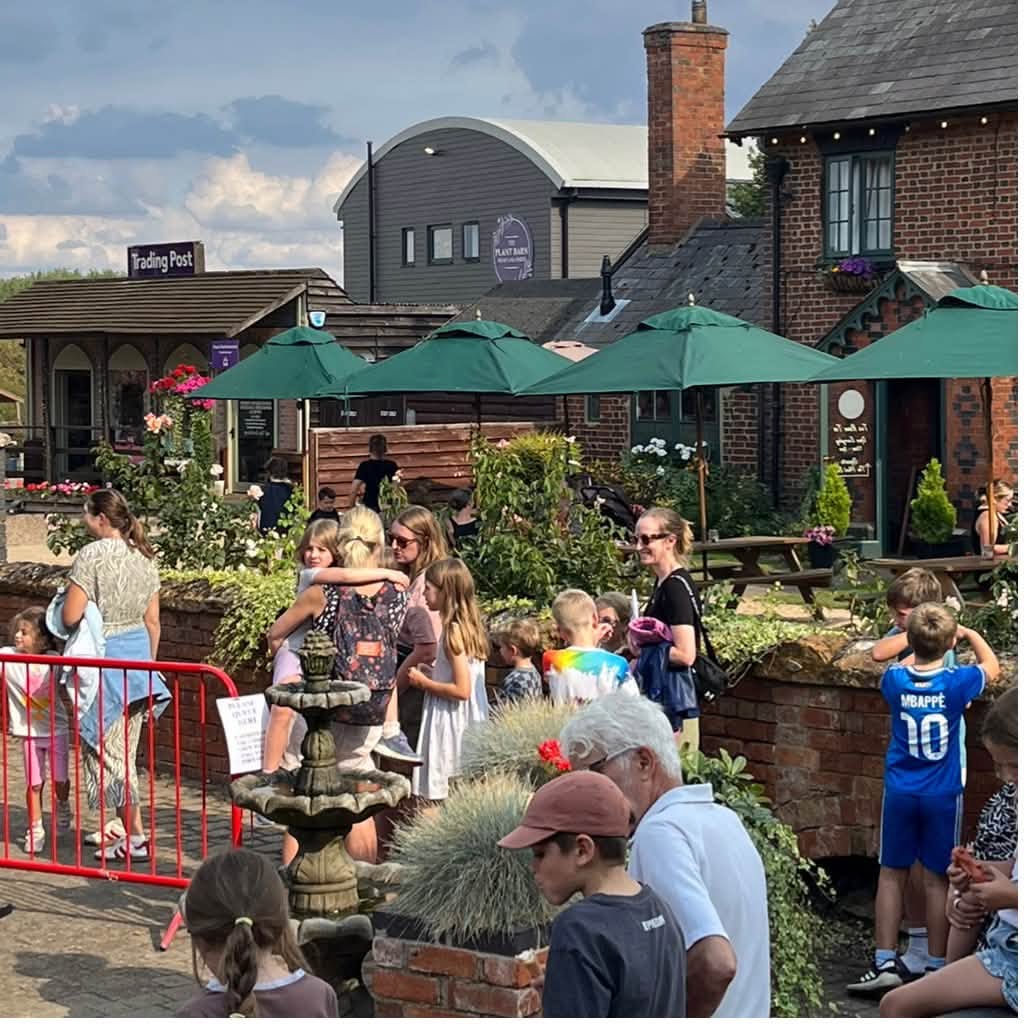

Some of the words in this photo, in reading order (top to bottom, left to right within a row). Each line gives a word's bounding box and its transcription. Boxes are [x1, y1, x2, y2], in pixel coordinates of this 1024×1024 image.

[132, 251, 169, 273] Trading
[169, 250, 193, 268] Post
[900, 711, 949, 760] 10
